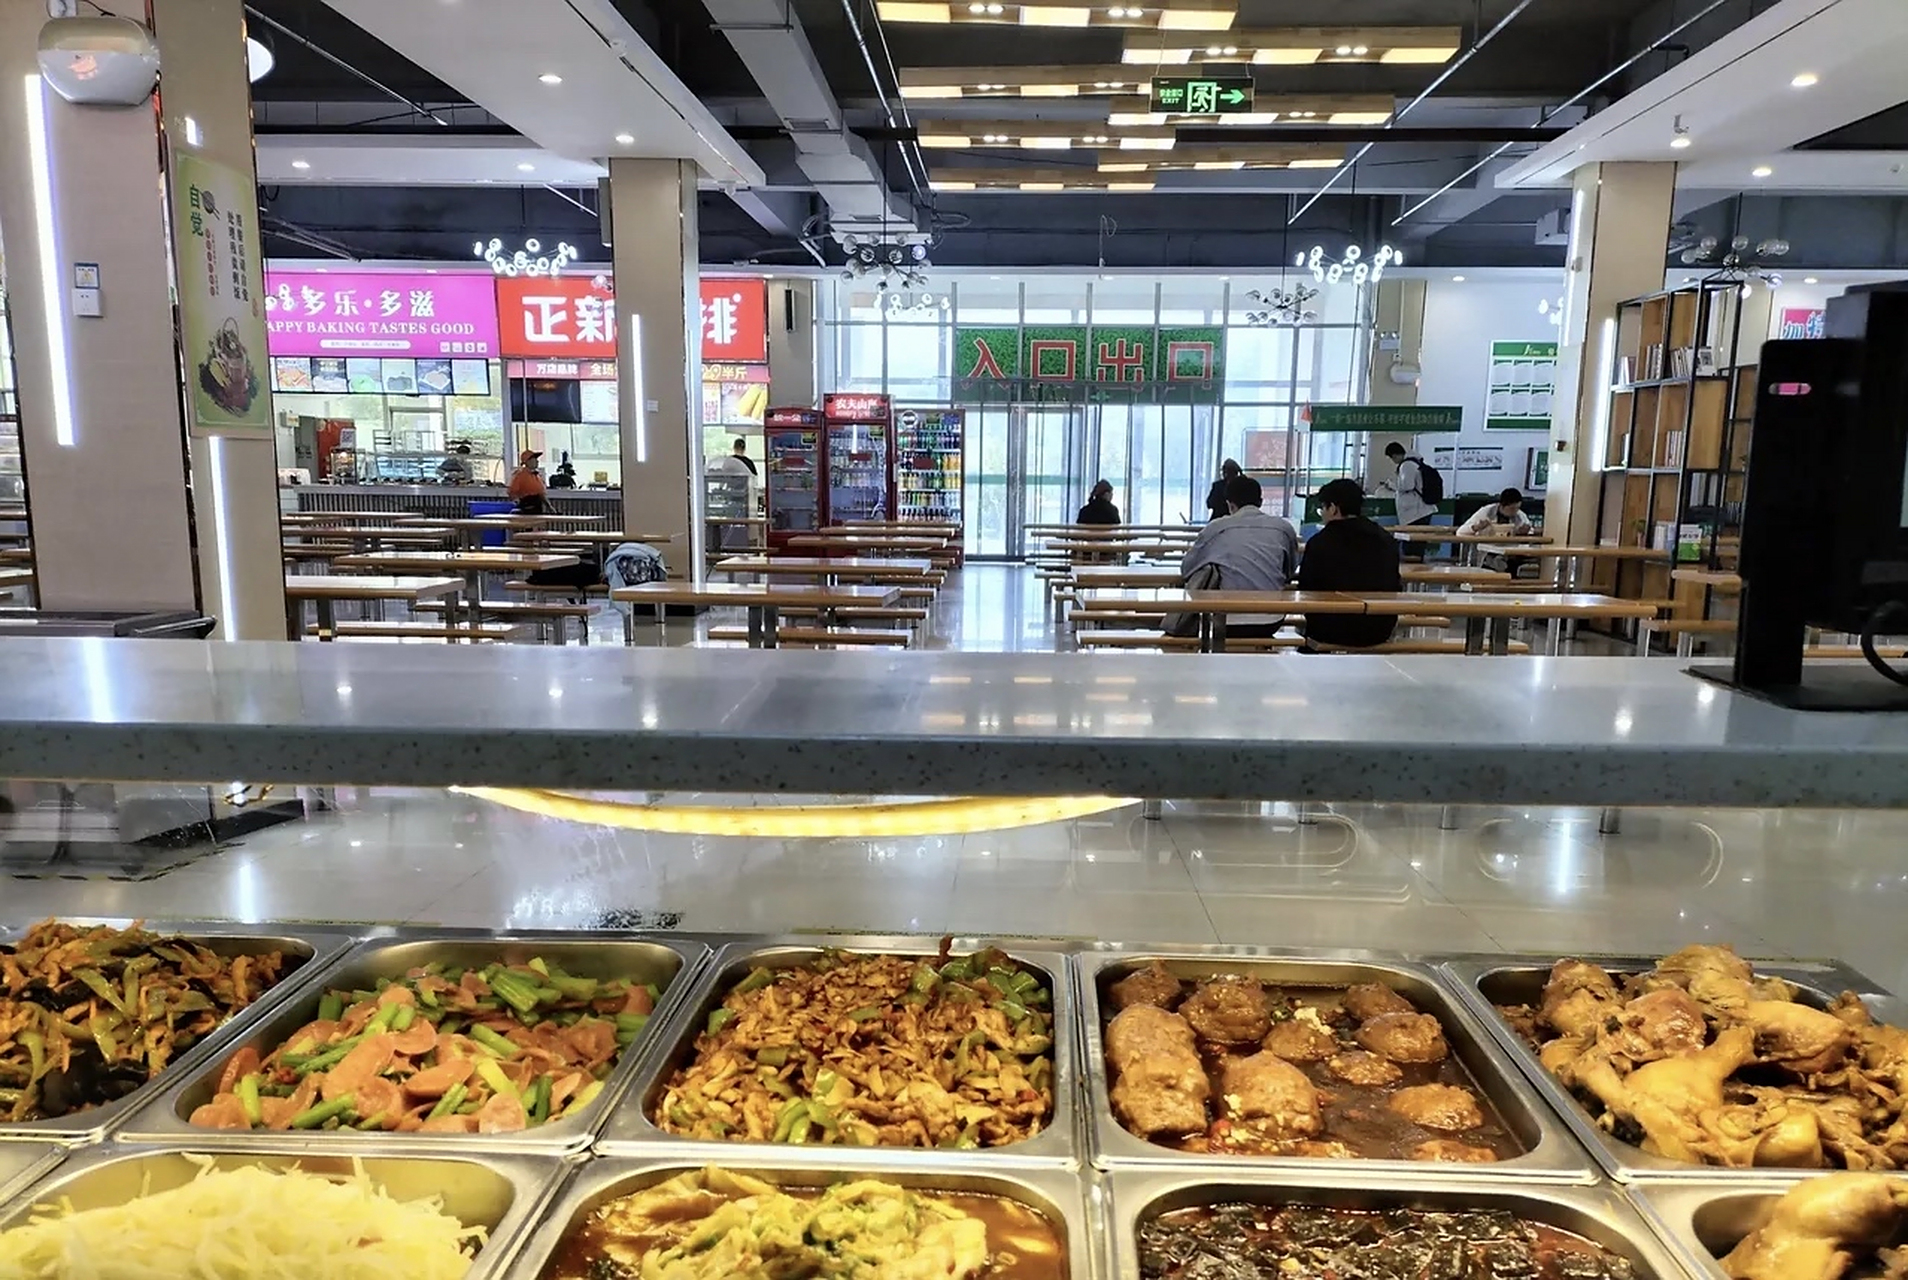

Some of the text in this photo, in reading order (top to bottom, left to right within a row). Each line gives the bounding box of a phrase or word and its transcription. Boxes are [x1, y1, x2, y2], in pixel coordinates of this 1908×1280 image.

[266, 320, 475, 336] APPY BAKING TASTES GOOD
[590, 361, 618, 376] 全场
